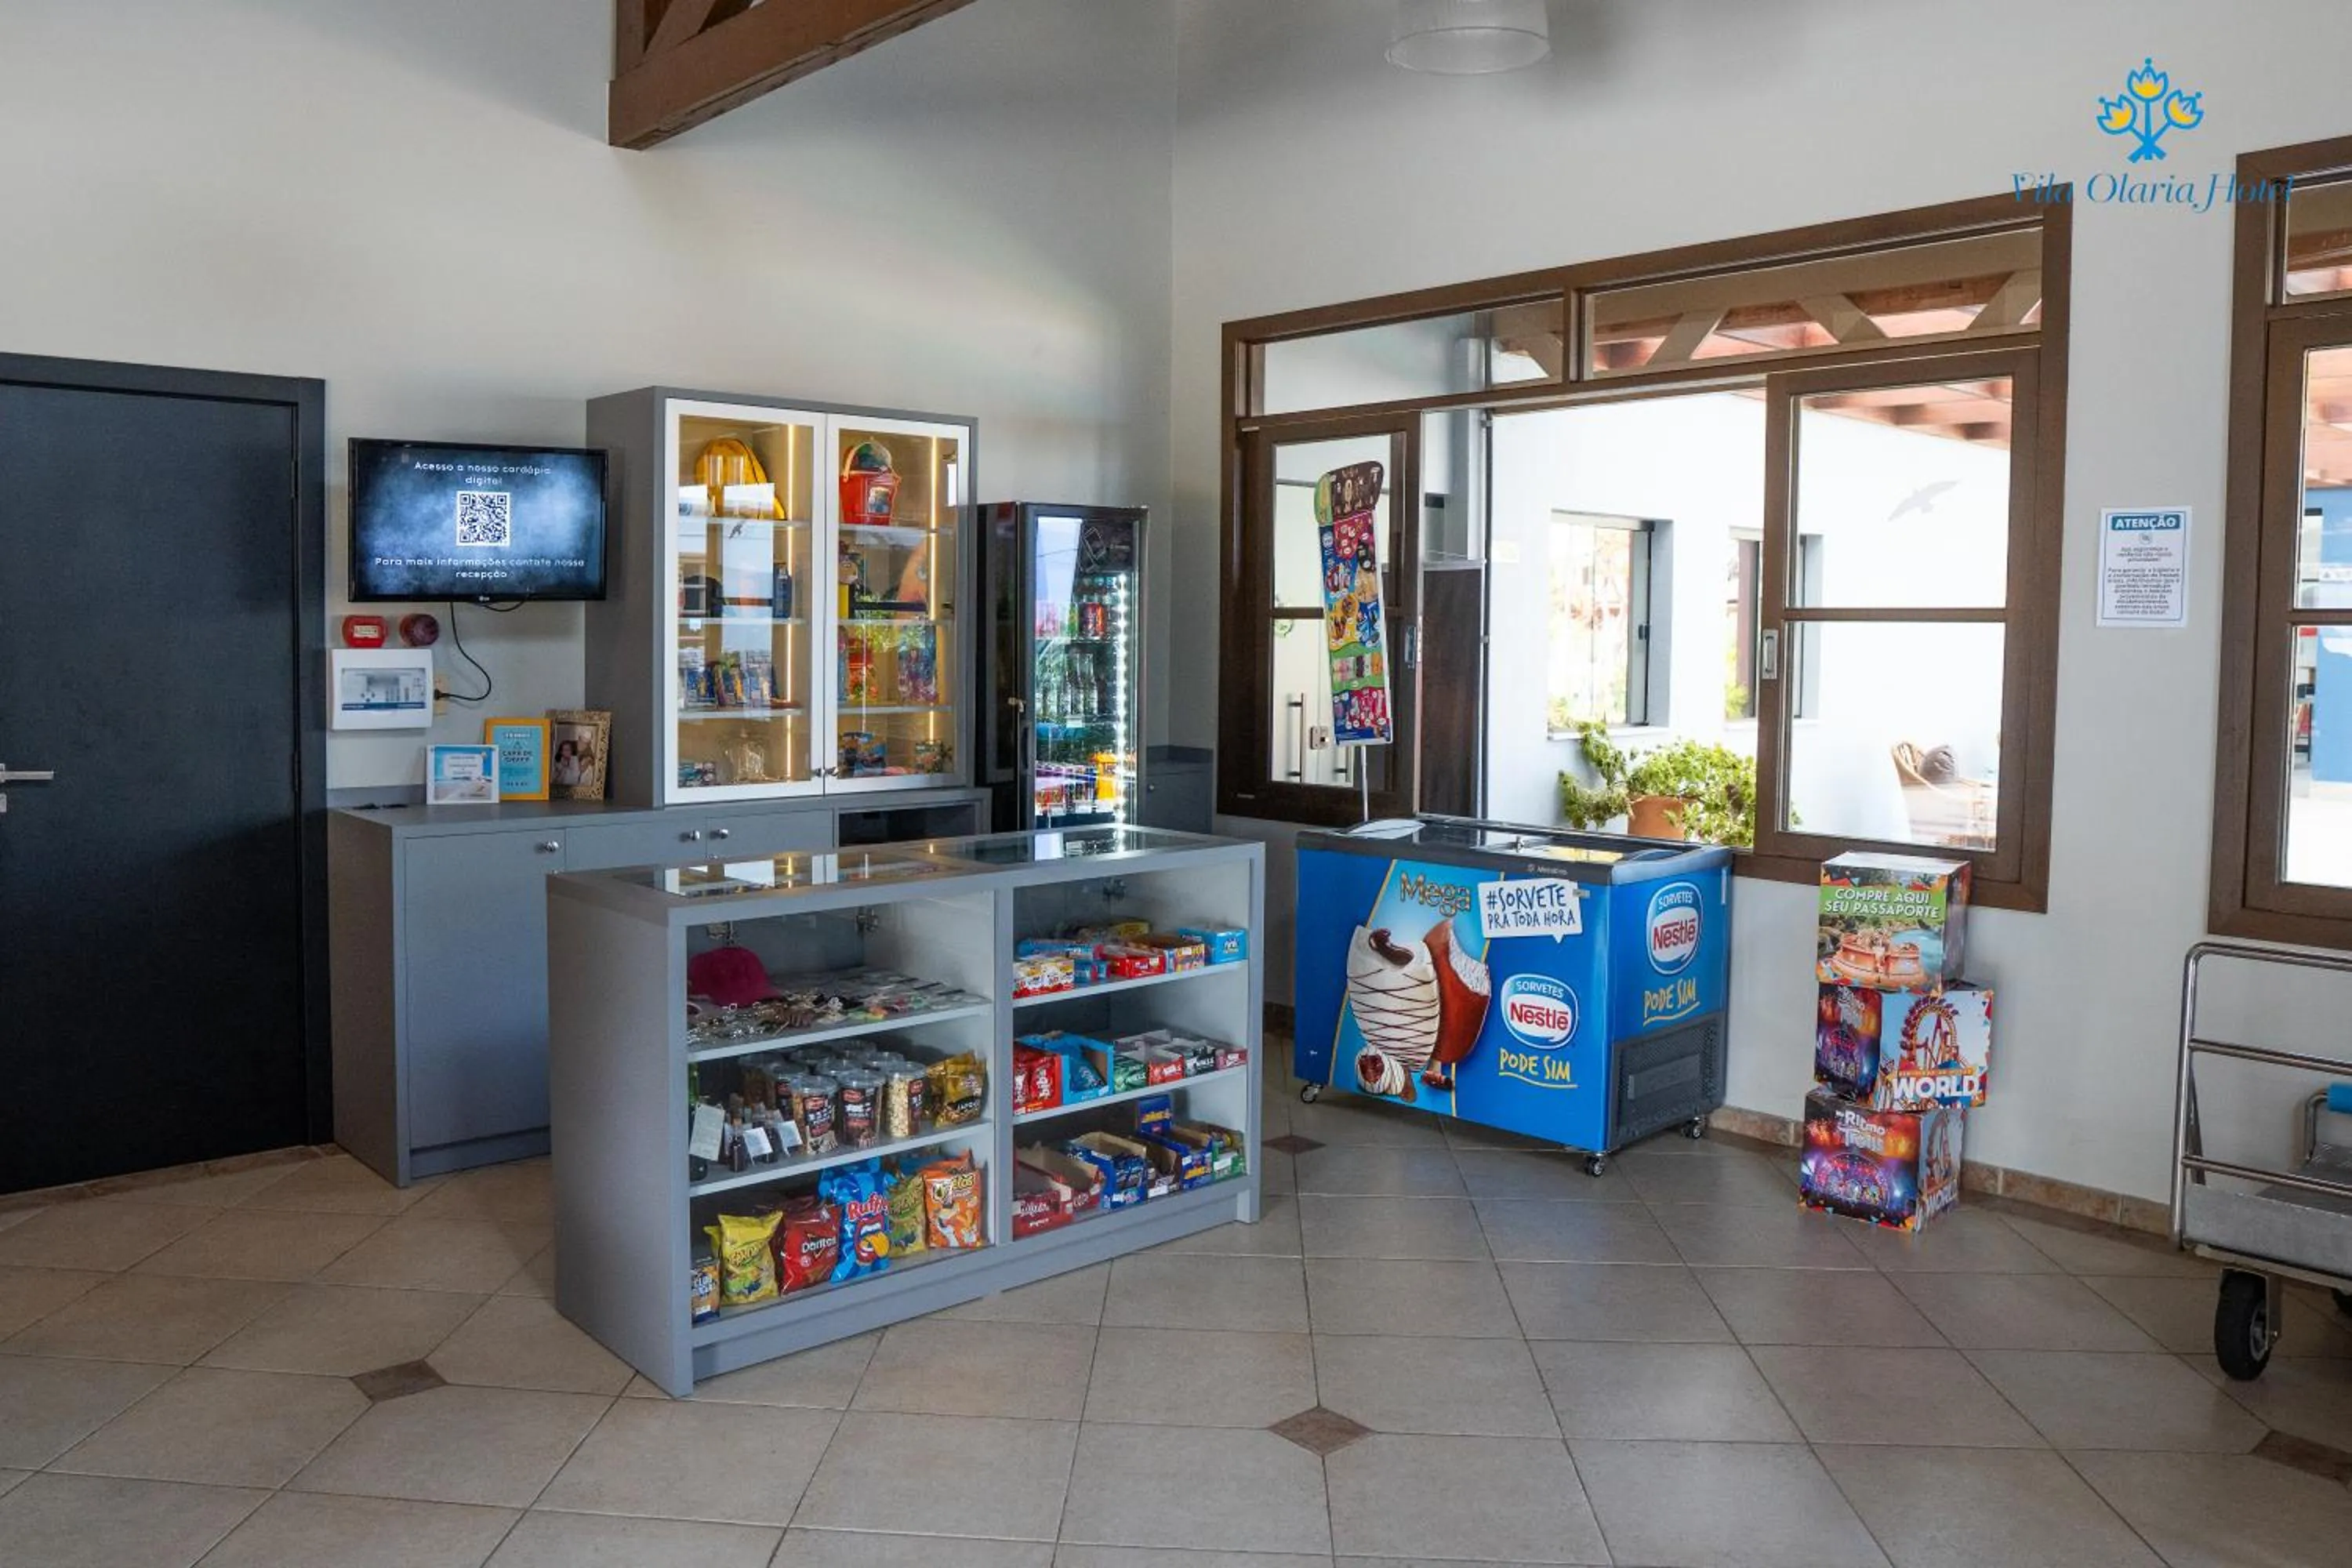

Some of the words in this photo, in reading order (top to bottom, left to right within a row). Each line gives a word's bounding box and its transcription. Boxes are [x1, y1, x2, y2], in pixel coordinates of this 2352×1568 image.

[468, 464, 499, 473] nosso
[465, 475, 503, 486] digital
[2114, 514, 2177, 532] ATENÇÃO
[437, 557, 506, 568] informações
[456, 569, 507, 580] recepção
[1400, 872, 1472, 917] Mega
[1486, 884, 1567, 911] #SORVETE
[1658, 891, 1693, 910] SORVETES
[1835, 888, 1890, 902] COMPRE
[1893, 891, 1930, 904] AQUI
[1488, 913, 1511, 928] PRA
[1514, 912, 1541, 927] TODA
[1544, 909, 1576, 927] HORA
[1824, 901, 1849, 913] SEU
[1853, 902, 1940, 919] PASSAPORTE
[1515, 981, 1564, 998] SORVETES
[1644, 984, 1675, 1018] PODE
[1677, 978, 1696, 1009] SIM
[1499, 1047, 1539, 1076] PODE
[1543, 1055, 1571, 1083] SIM
[1892, 1075, 1980, 1100] WORLD
